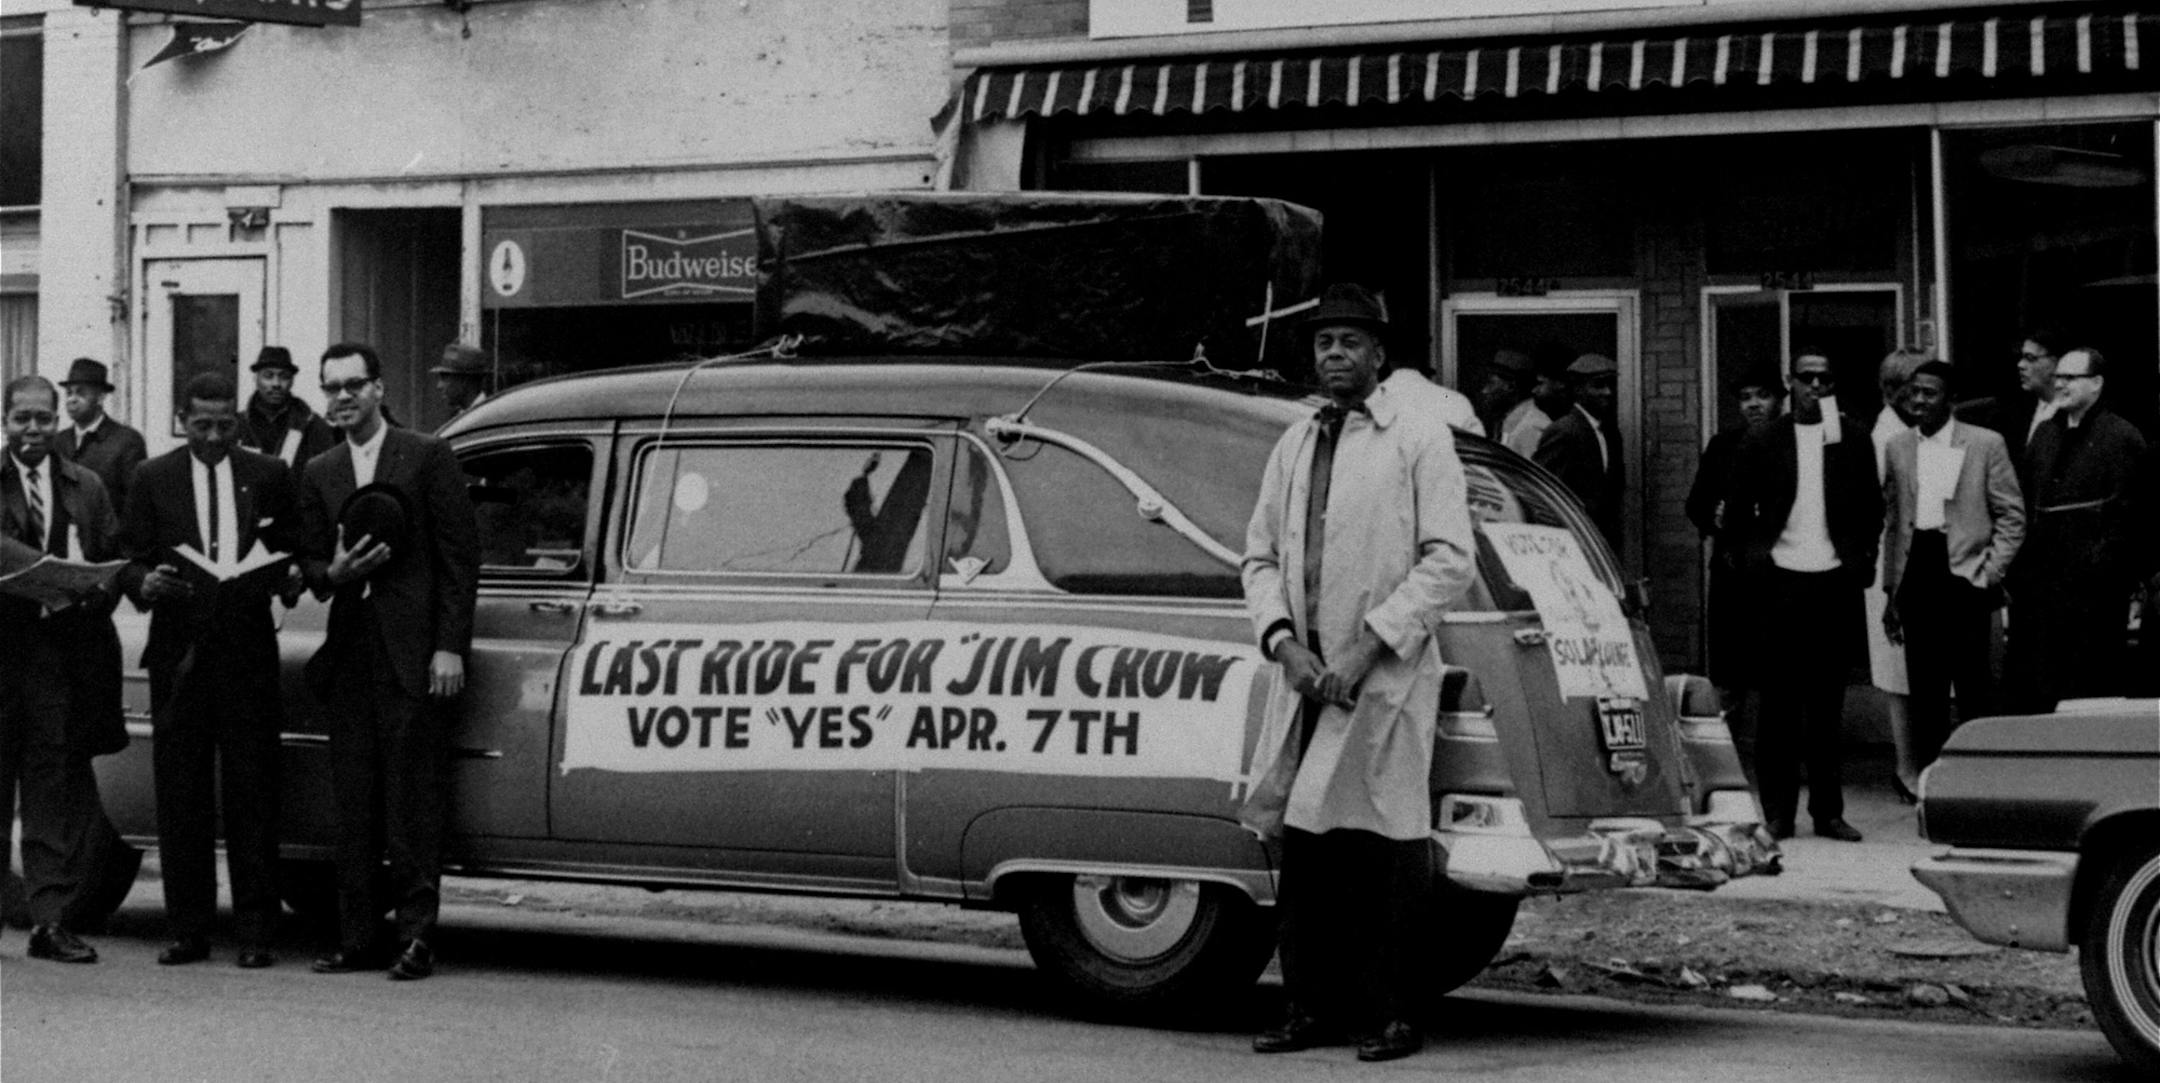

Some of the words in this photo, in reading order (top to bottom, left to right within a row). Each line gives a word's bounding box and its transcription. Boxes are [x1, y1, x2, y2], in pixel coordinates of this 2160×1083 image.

[627, 244, 757, 280] Budweise
[579, 639, 706, 696] LAST
[699, 639, 834, 696] RIDE
[835, 638, 945, 696] FOR
[1075, 644, 1246, 702] CROW
[627, 706, 752, 749] VOTE
[765, 705, 893, 749] "YES"
[906, 706, 1007, 752] APR.
[1026, 709, 1140, 757] 7TH
